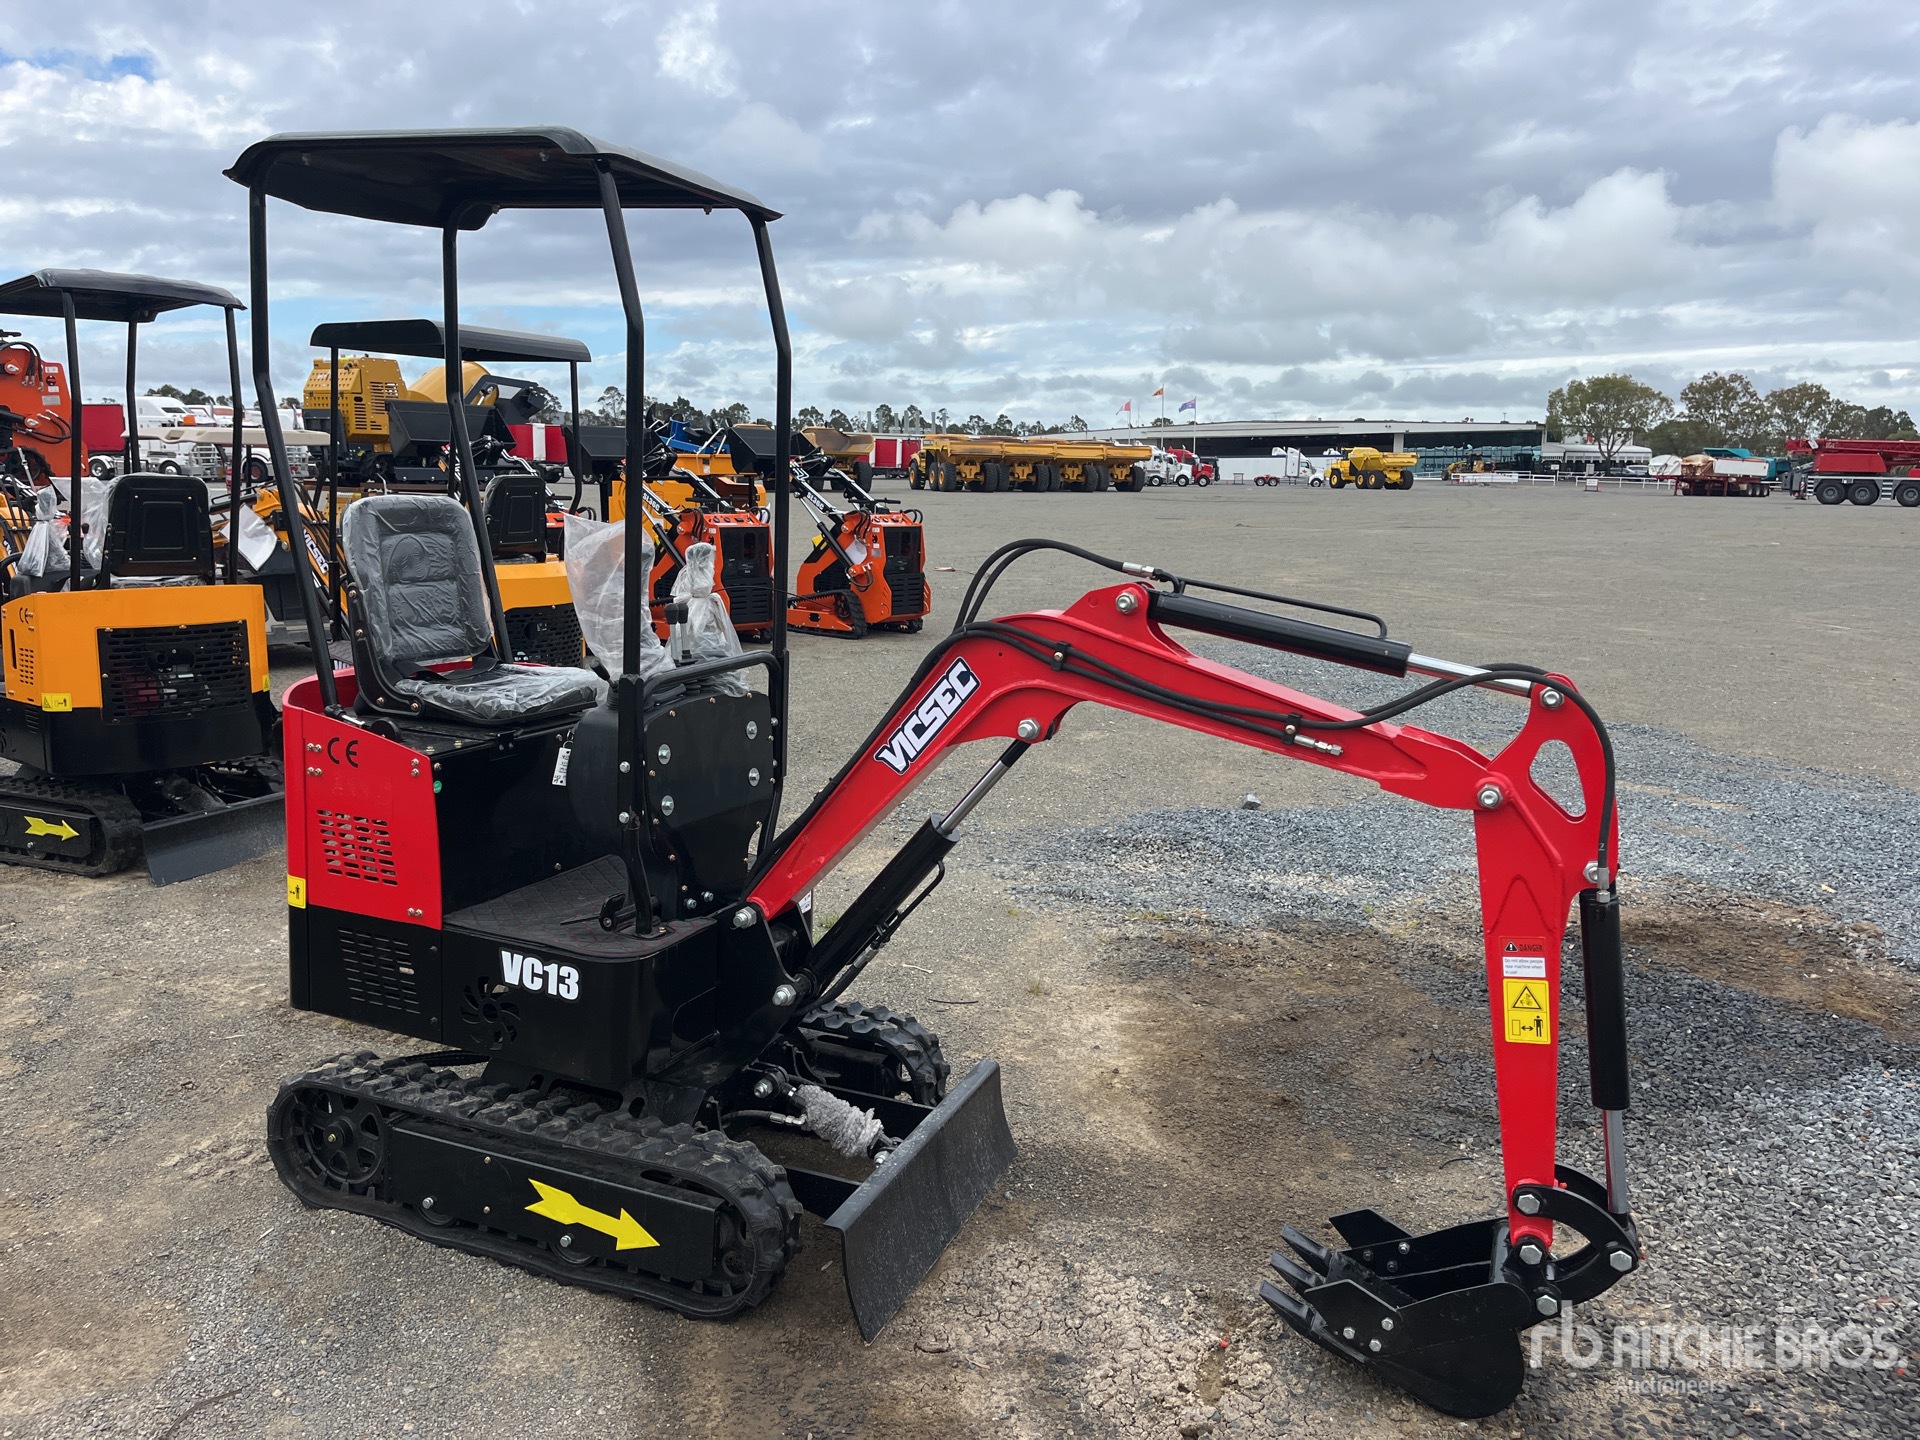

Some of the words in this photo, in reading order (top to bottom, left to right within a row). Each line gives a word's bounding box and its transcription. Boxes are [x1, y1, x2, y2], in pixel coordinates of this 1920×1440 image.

[876, 660, 979, 773] VICSEC
[327, 737, 359, 768] CE
[1519, 944, 1542, 952] DANGER
[501, 950, 579, 1000] VC13
